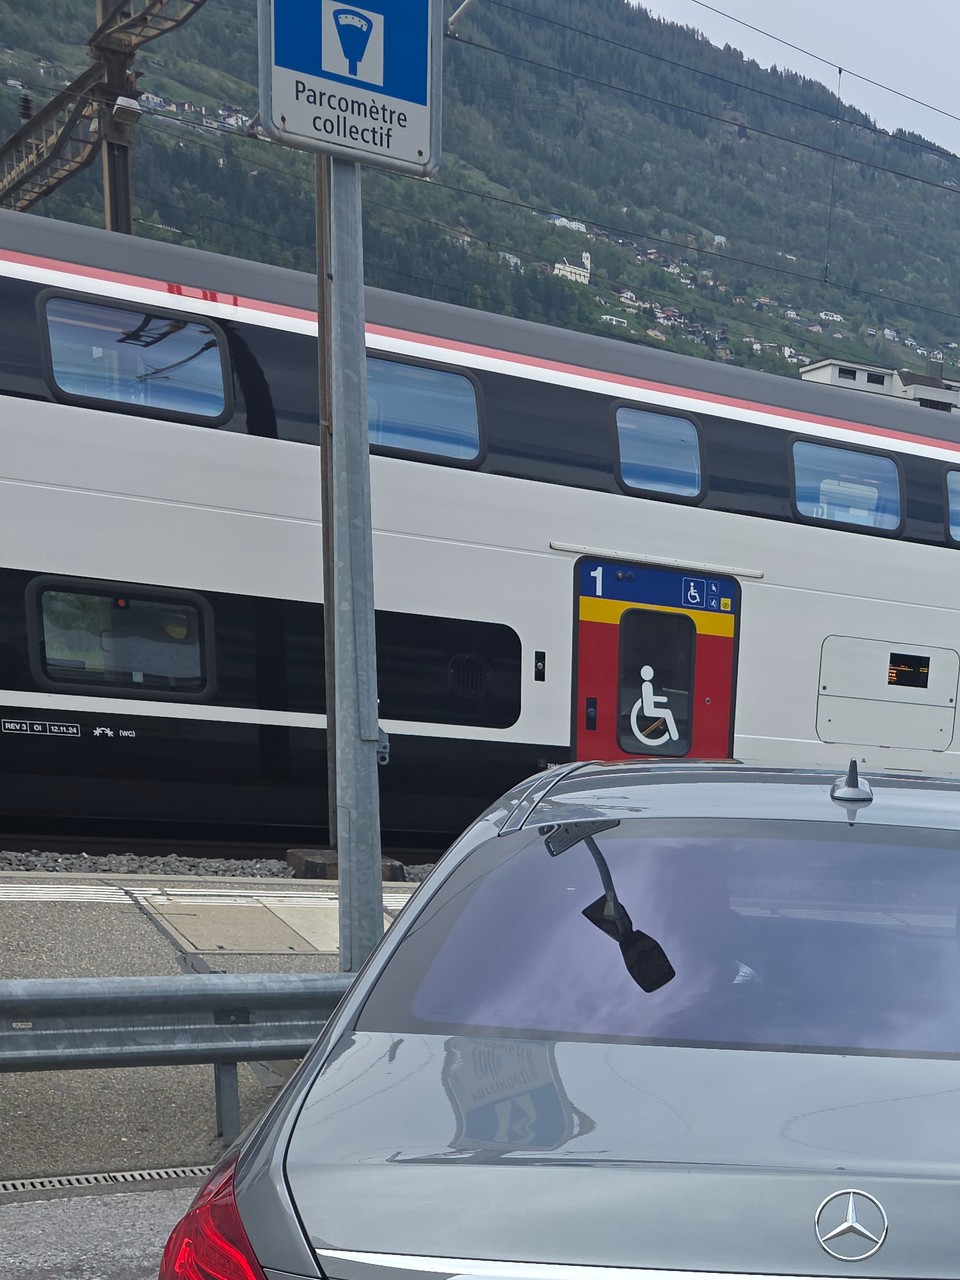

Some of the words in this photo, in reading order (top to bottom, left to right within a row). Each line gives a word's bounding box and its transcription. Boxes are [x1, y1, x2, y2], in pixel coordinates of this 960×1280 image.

[294, 80, 408, 128] Parcomètre
[312, 114, 393, 149] collectif
[590, 566, 603, 596] 1
[5, 722, 20, 730] REV
[21, 723, 27, 731] 3
[50, 725, 77, 734] 12.11.24
[119, 729, 136, 737] (WC)
